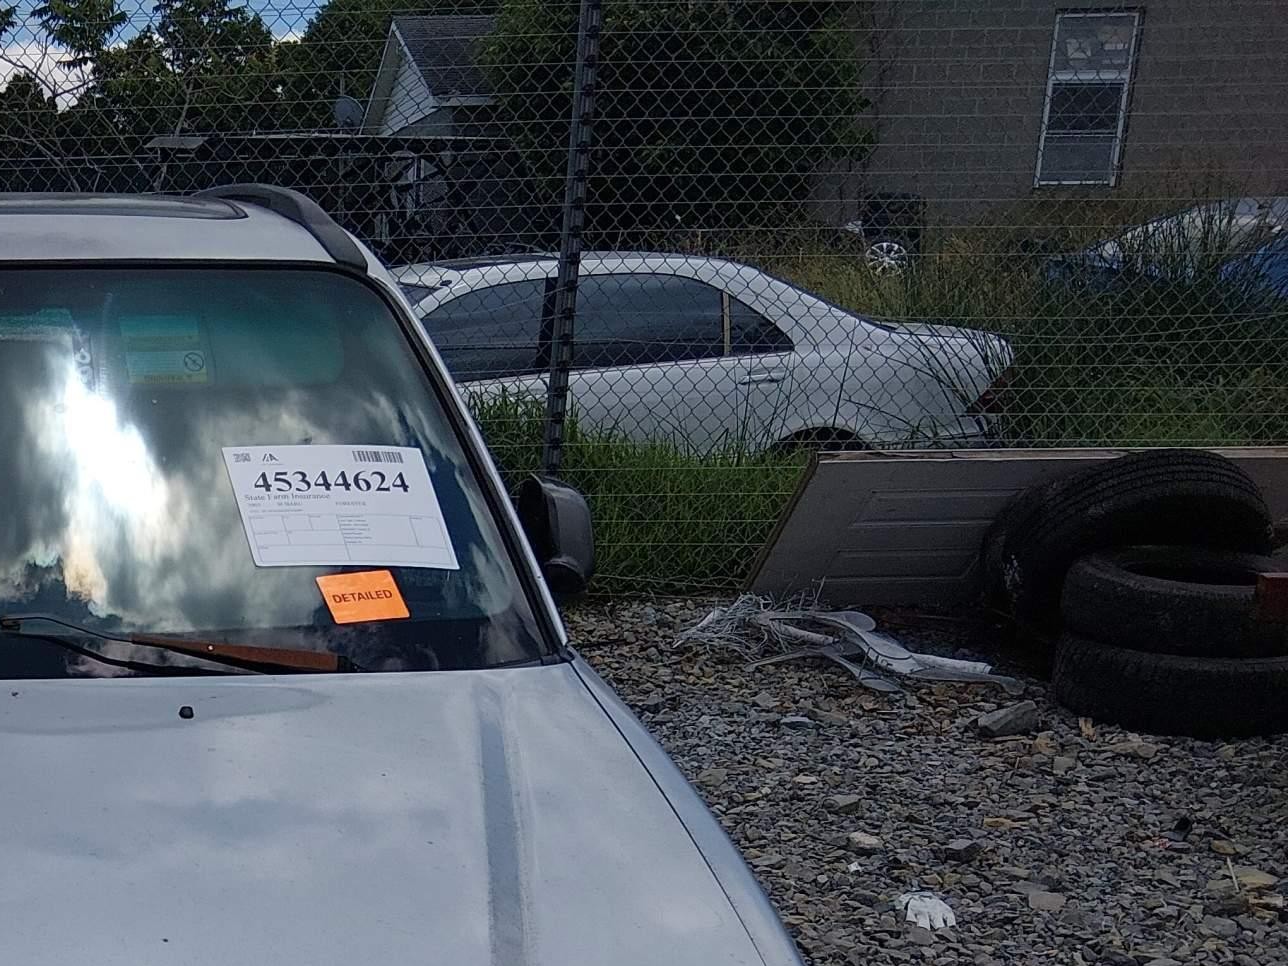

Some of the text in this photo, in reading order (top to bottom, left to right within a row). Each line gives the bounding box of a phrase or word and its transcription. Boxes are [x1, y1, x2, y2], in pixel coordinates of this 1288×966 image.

[254, 470, 410, 493] 45344624
[291, 492, 330, 500] Insurance
[332, 590, 392, 603] DETAILED
